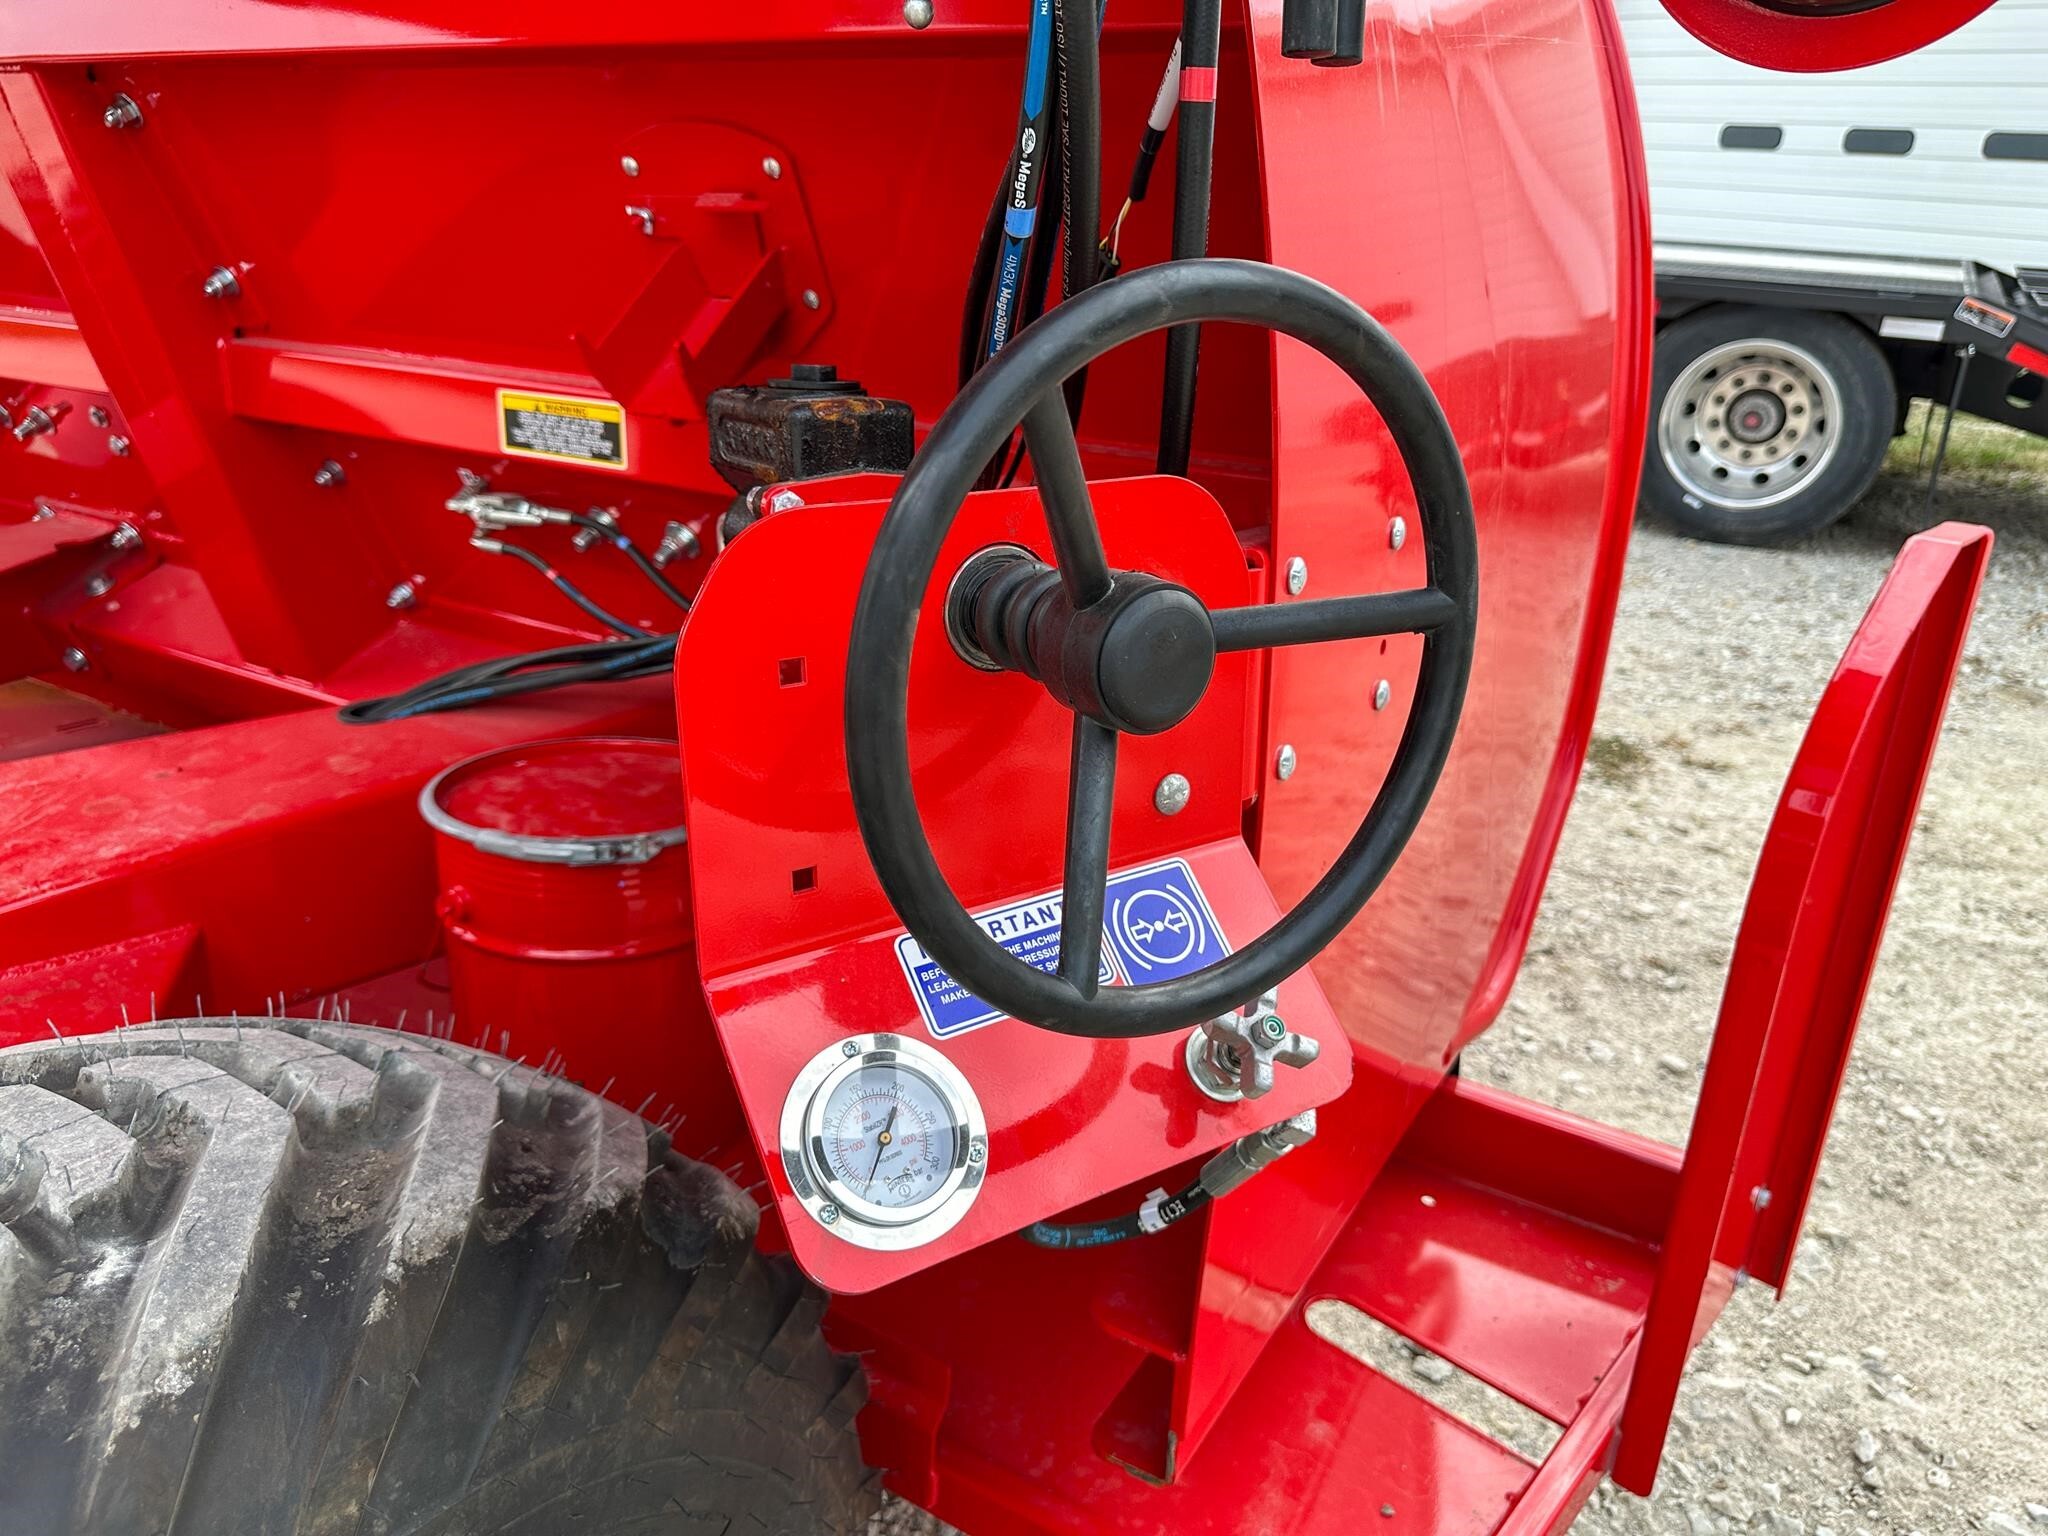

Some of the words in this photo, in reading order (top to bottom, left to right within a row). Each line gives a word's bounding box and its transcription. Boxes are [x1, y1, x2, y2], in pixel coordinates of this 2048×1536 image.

[1015, 160, 1032, 211] MegaS
[1003, 254, 1018, 286] 4M3K
[940, 988, 972, 1005] MAKE
[891, 1081, 905, 1093] 200
[849, 1139, 865, 1153] 1000
[900, 1133, 917, 1147] 4000
